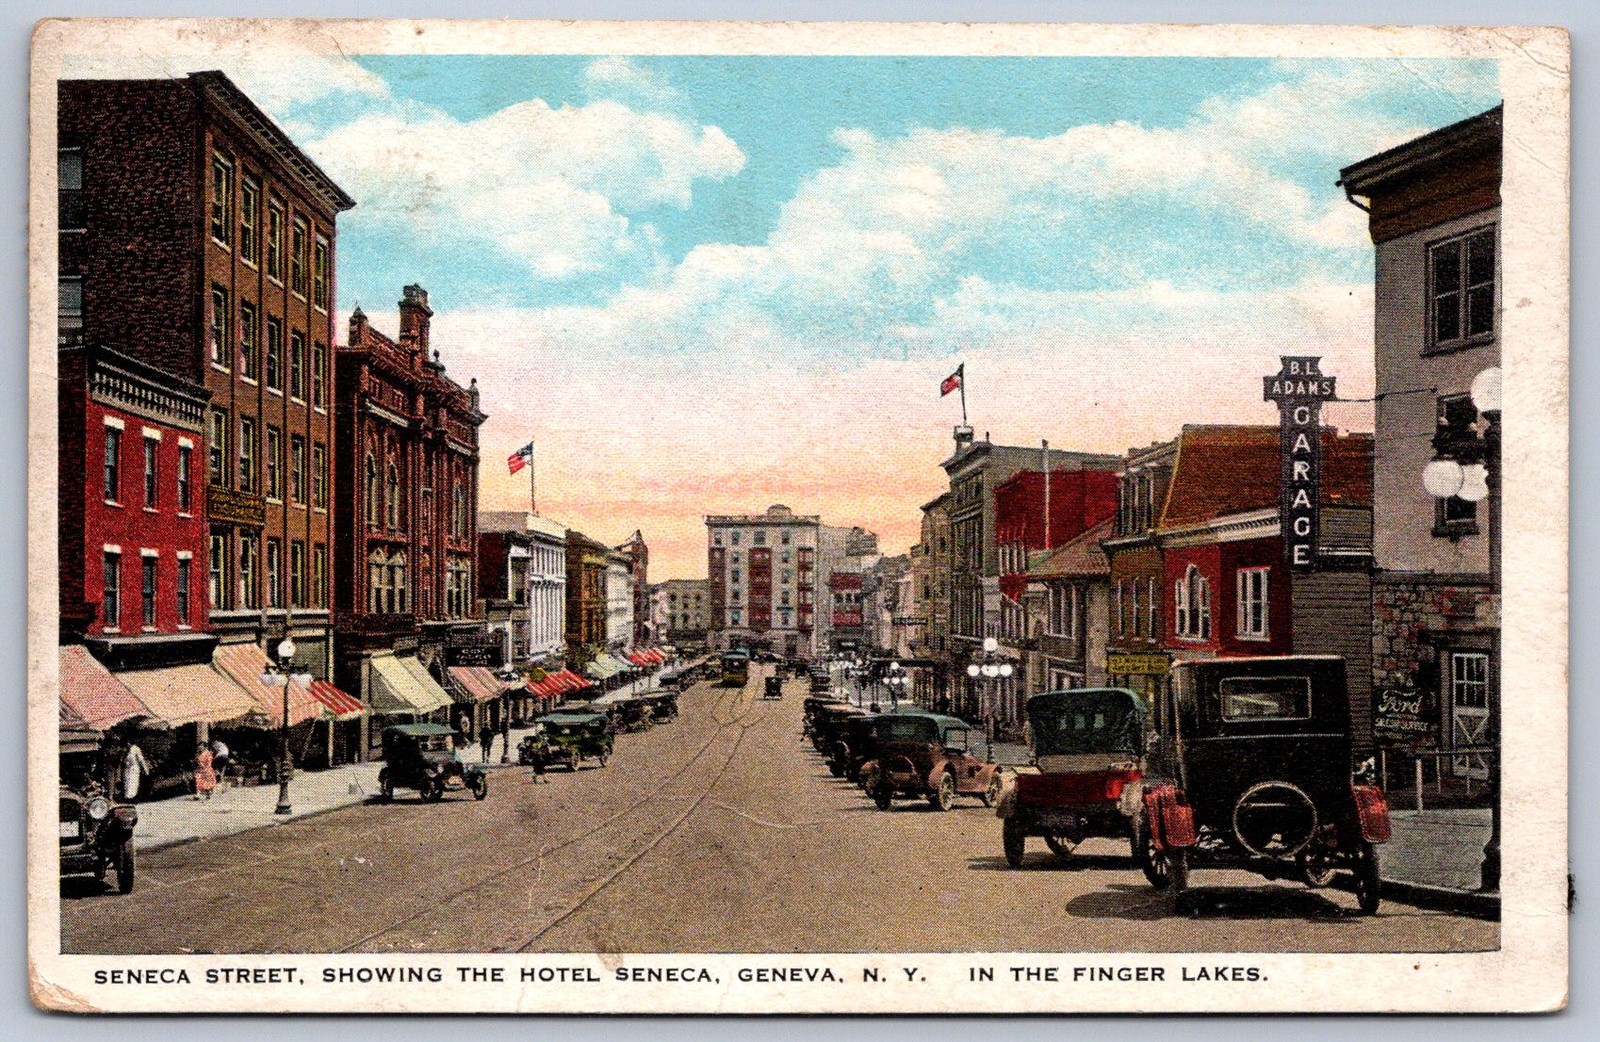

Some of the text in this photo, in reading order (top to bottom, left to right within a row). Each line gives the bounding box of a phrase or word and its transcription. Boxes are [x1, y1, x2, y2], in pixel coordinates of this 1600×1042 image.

[1272, 381, 1331, 395] ADAMS
[1292, 406, 1312, 565] GARAGE
[1378, 689, 1423, 714] Ford
